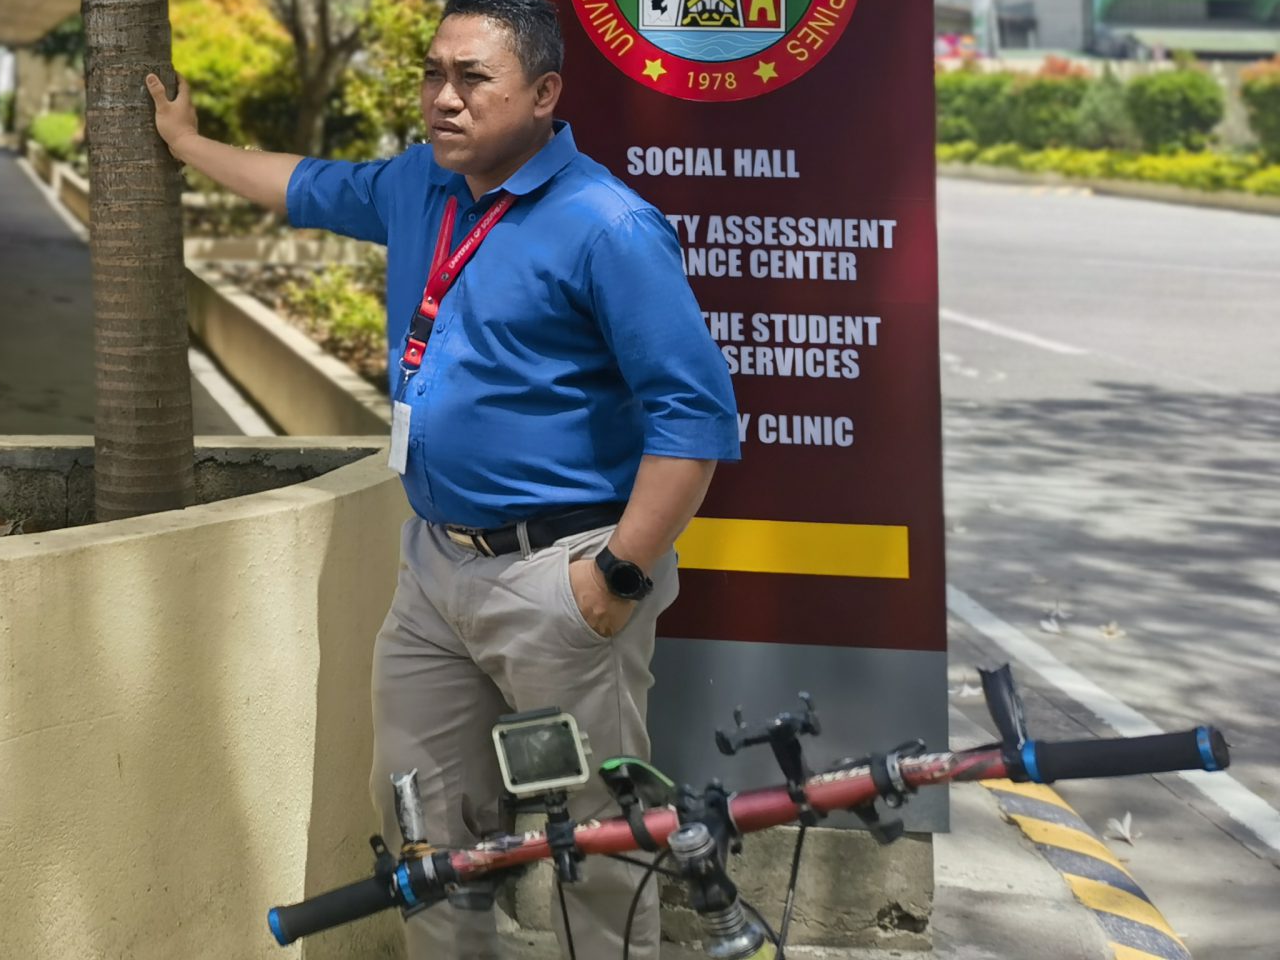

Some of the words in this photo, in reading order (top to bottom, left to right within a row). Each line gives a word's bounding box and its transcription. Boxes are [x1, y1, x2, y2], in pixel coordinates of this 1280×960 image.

[687, 71, 737, 90] 1978
[627, 146, 726, 176] SOCIAL
[733, 149, 800, 178] HALL
[706, 214, 897, 249] ASSESSMENT
[749, 248, 857, 281] CENTER
[751, 312, 882, 346] STUDENT
[720, 344, 860, 379] SERVICES
[758, 413, 854, 447] CLINIC
